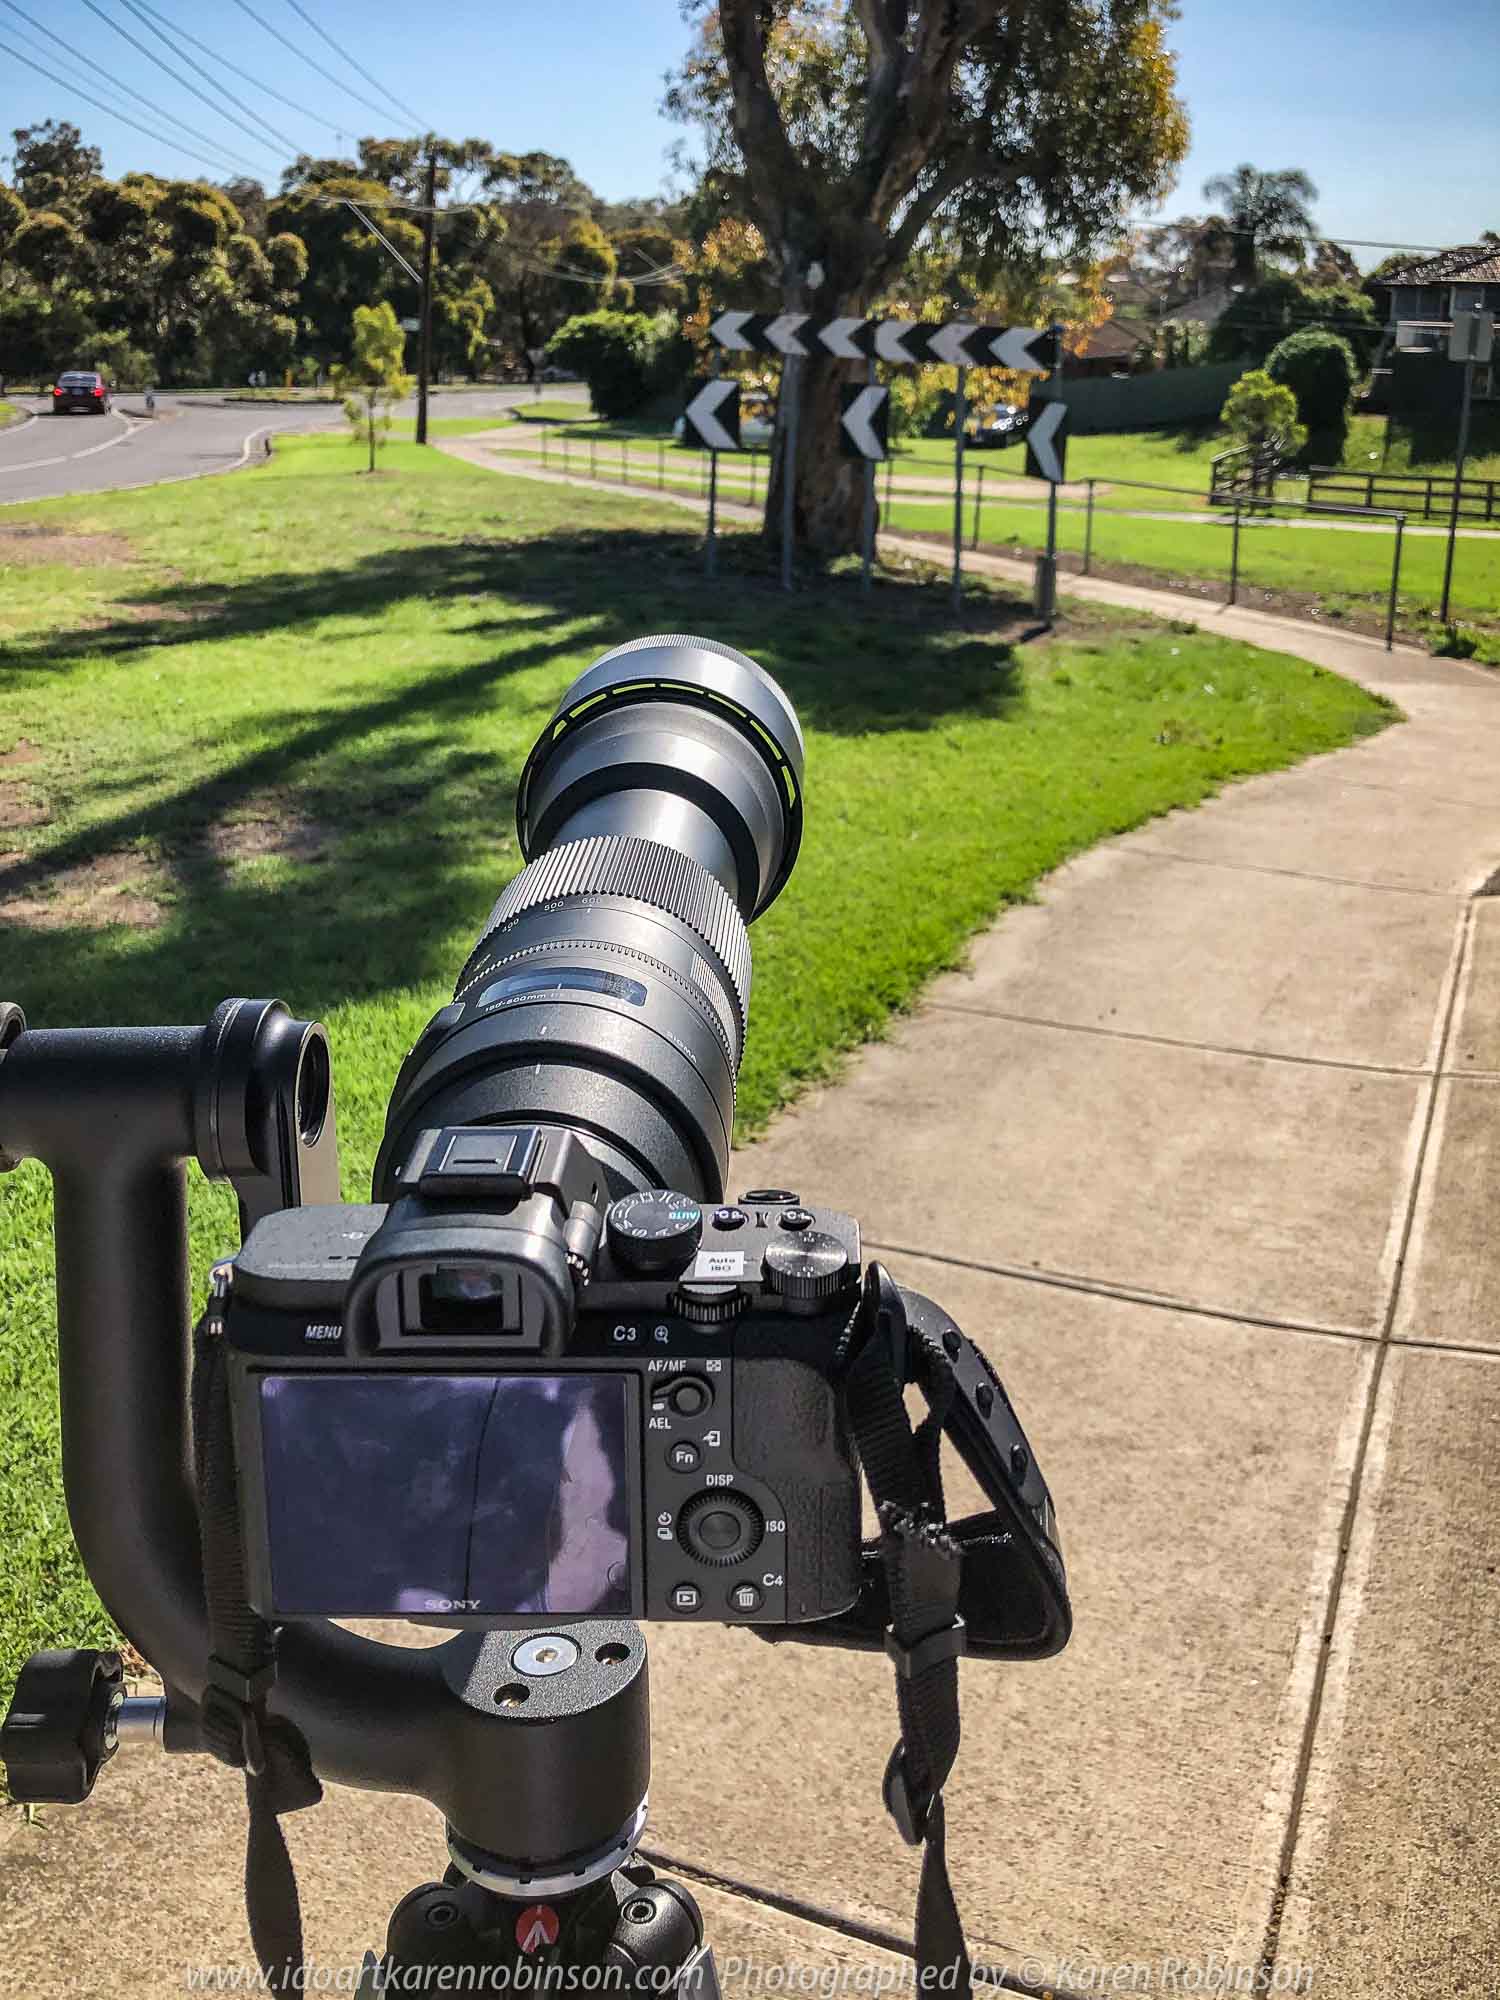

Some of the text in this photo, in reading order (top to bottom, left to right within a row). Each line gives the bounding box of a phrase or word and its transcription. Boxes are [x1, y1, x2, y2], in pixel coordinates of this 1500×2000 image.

[544, 901, 564, 911] 500
[668, 1211, 697, 1220] AUTO
[305, 1325, 343, 1340] MENU
[613, 1325, 637, 1341] C3
[648, 1359, 687, 1372] AF/MF
[649, 1417, 672, 1430] AEL
[675, 1451, 695, 1464] Fn
[706, 1474, 734, 1487] DISP
[765, 1520, 786, 1533] ISO
[762, 1573, 783, 1586] C4
[424, 1600, 480, 1609] SONY
